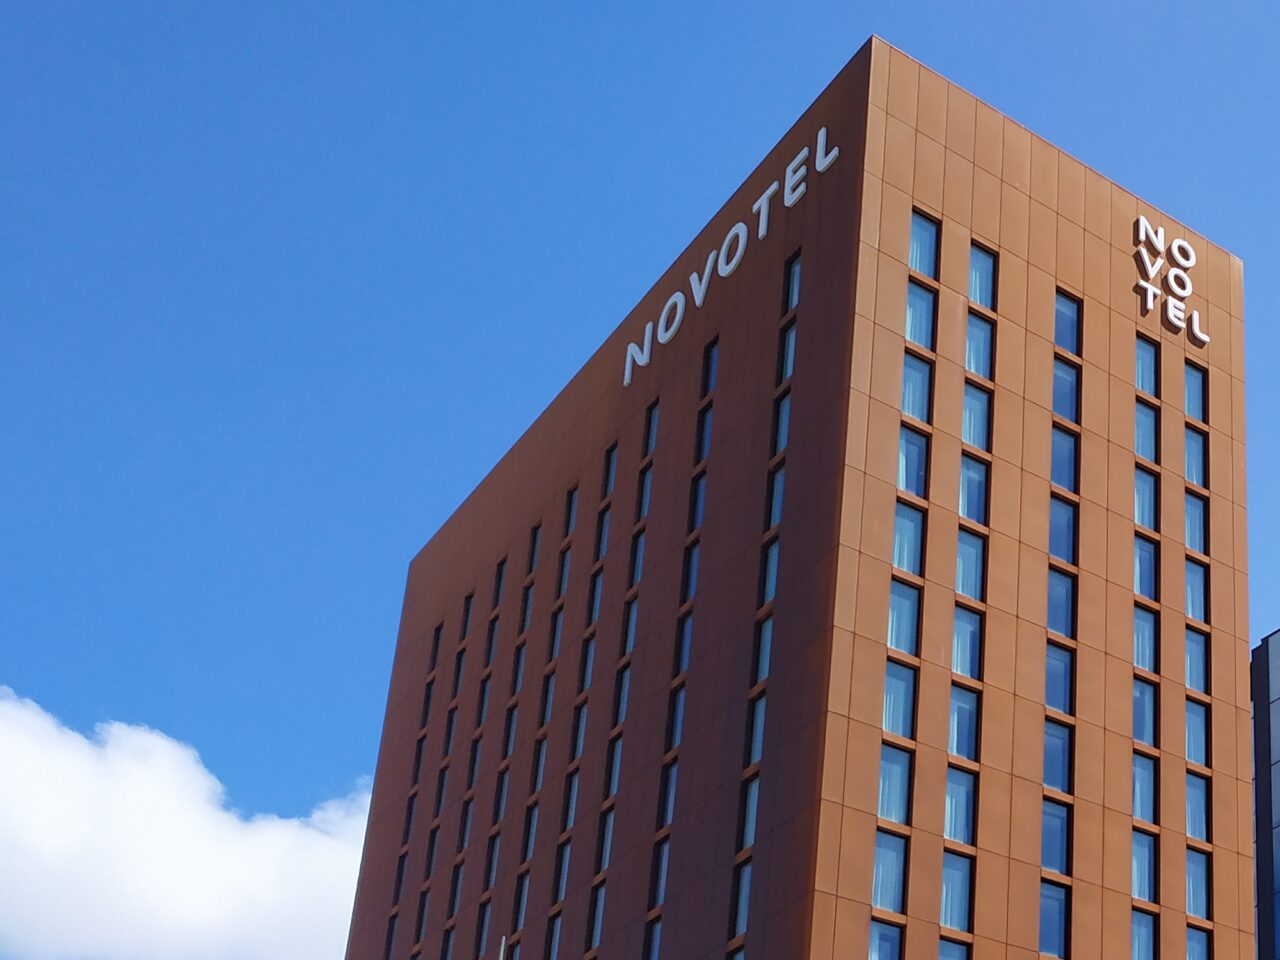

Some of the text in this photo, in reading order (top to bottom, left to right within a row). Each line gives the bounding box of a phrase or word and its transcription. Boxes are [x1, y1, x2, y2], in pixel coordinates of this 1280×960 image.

[623, 126, 839, 388] NOVOTEL
[1138, 214, 1197, 268] NO
[1137, 244, 1193, 298] VO
[1137, 279, 1211, 343] TEL
